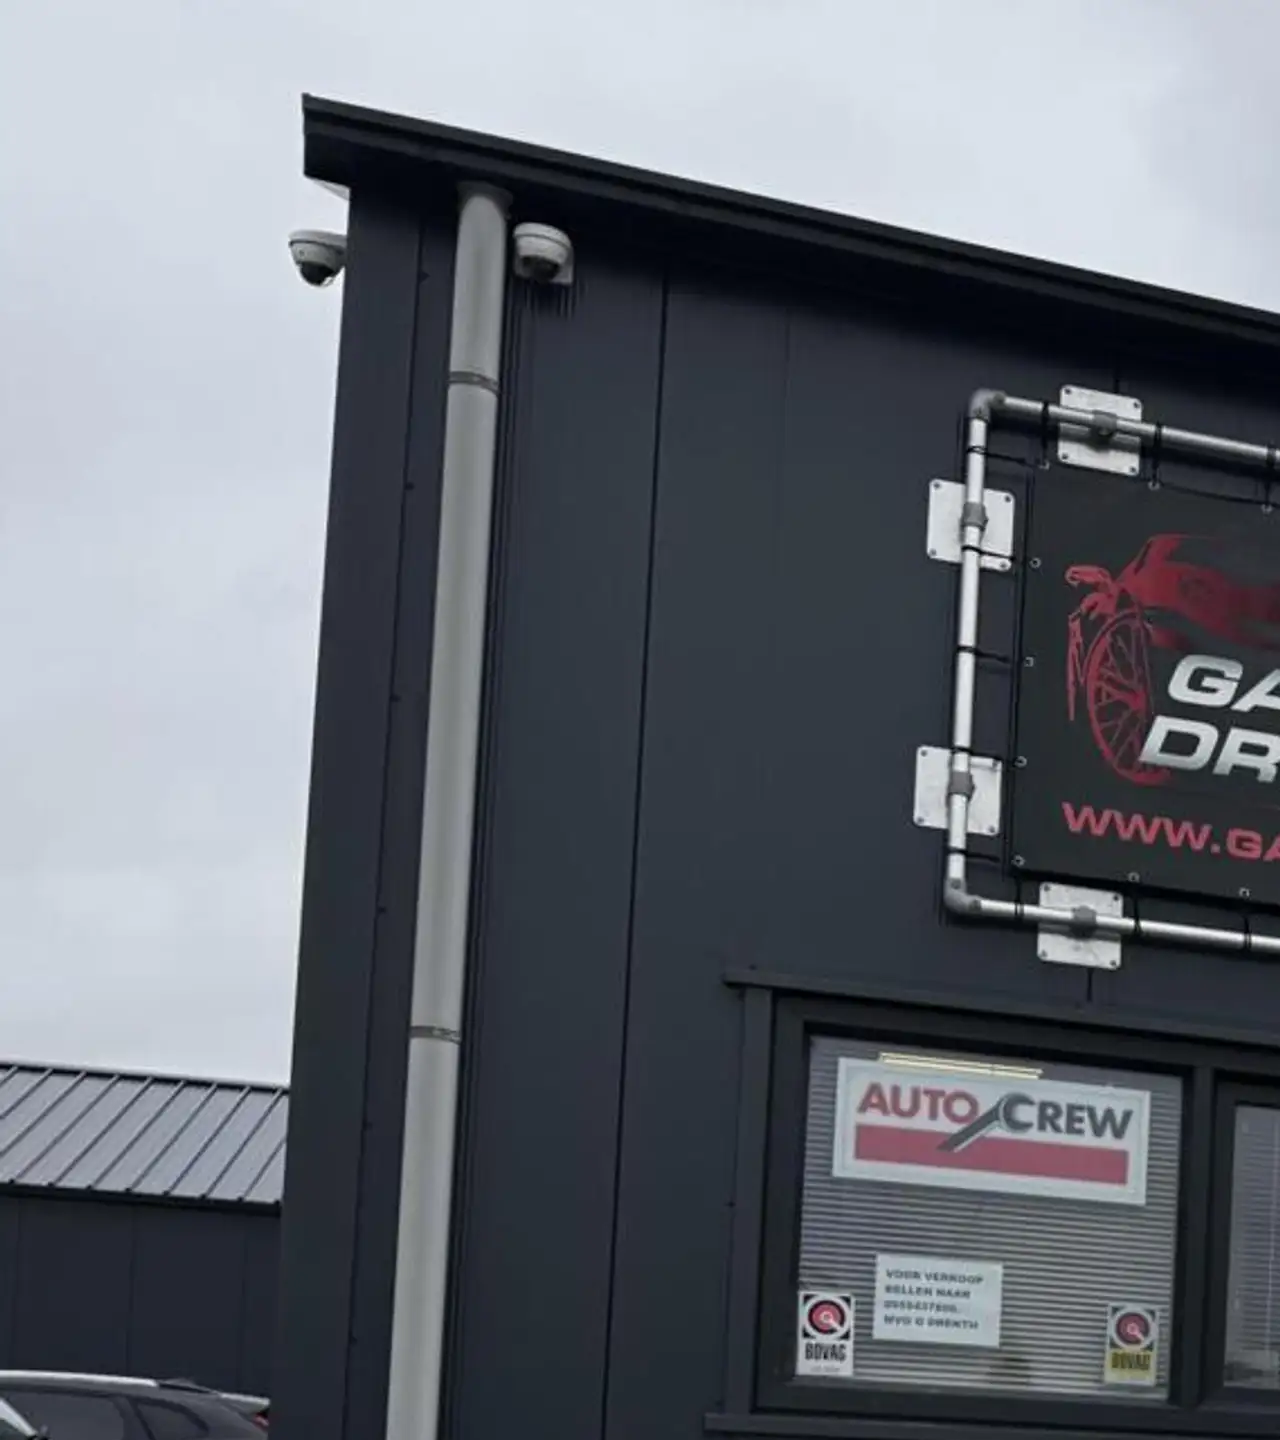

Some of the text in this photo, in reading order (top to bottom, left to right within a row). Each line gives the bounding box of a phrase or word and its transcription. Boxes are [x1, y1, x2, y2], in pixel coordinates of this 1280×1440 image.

[856, 1081, 1134, 1140] AUTO CREW
[804, 1342, 847, 1362] BOVAG
